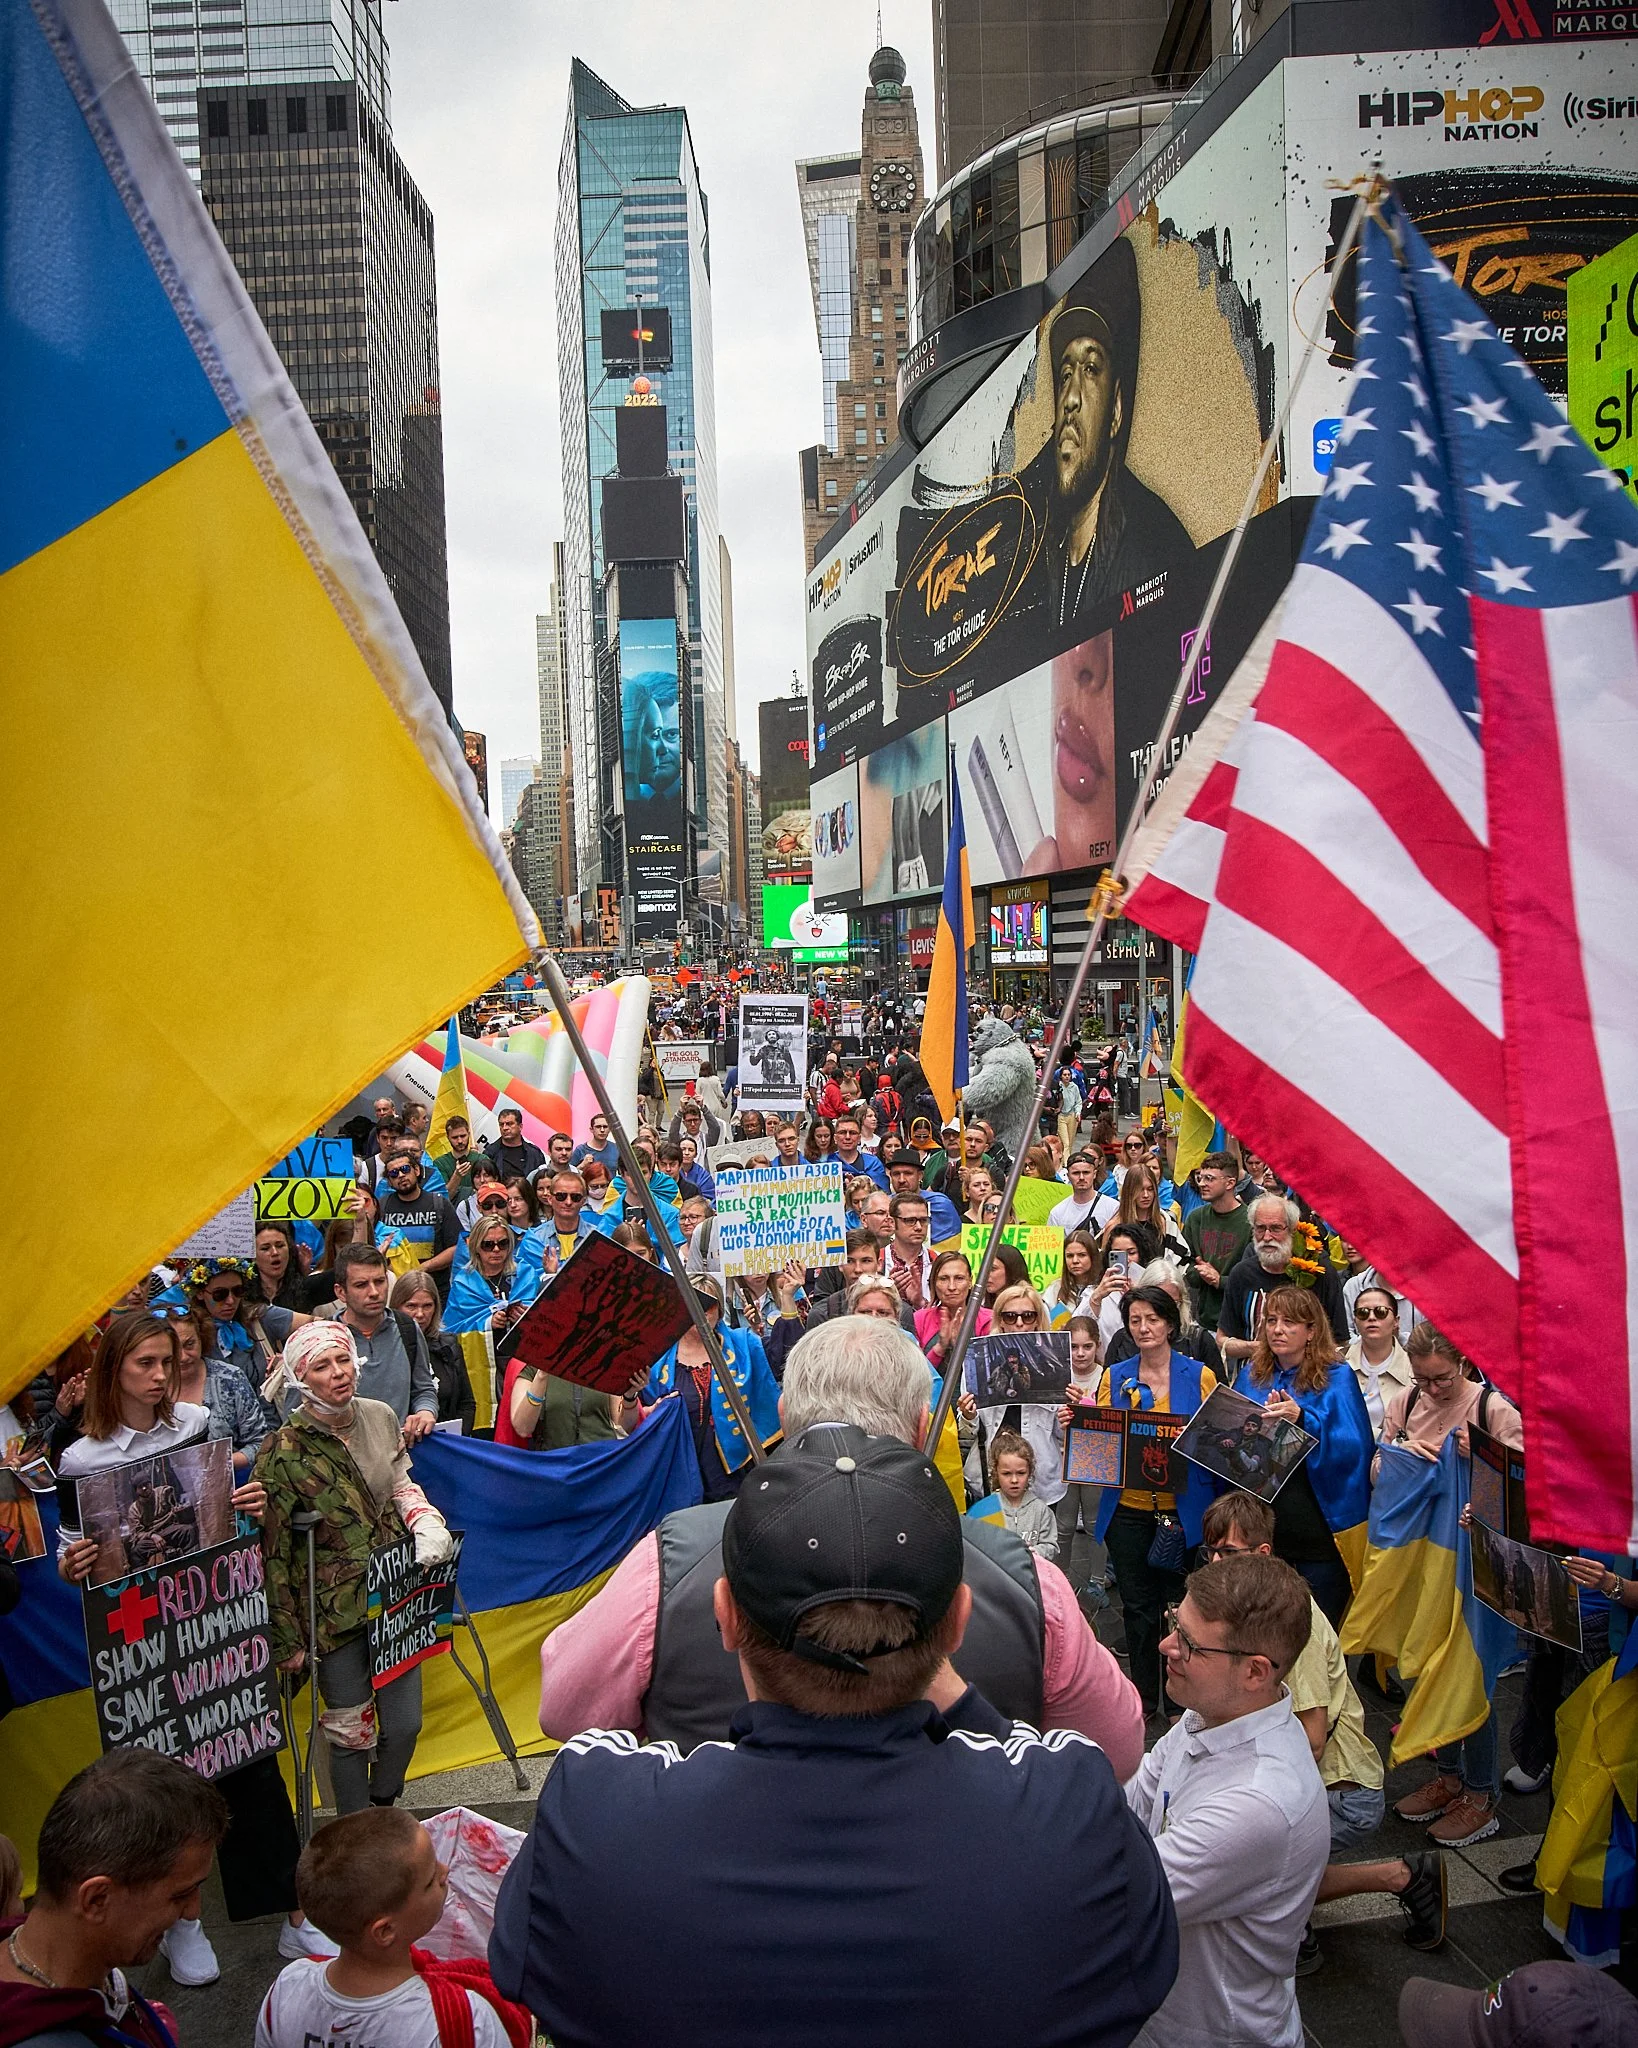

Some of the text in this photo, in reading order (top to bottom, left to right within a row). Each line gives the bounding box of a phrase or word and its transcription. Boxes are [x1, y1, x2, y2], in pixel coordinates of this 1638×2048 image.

[1586, 96, 1638, 120] Siri
[1444, 122, 1539, 142] NATION
[1138, 128, 1187, 193] MARRIOTT
[1138, 156, 1182, 212] MARQUIS
[1523, 325, 1565, 342] TOR
[901, 331, 941, 376] MARRIOTT
[903, 353, 935, 392] MARQUIS
[624, 394, 657, 407] 2022
[1136, 571, 1168, 597] MARRIOTT
[823, 586, 842, 613] NATION
[1136, 586, 1165, 608] MARQUIS
[933, 609, 986, 657] THE TOR GUIDE
[867, 699, 876, 714] APP
[998, 733, 1013, 772] REFY
[628, 844, 683, 854] STAIRCASE
[1089, 841, 1111, 859] REFY
[815, 950, 835, 959] NEW
[405, 1073, 436, 1101] Pneuhaus
[804, 1163, 840, 1177] АЗОВ
[717, 1188, 841, 1214] ВЕСЬ СВІТ МОЛИТЬСЯ
[745, 1209, 764, 1224] ЗА
[800, 1215, 833, 1230] БОГА
[722, 1225, 842, 1251] ЩОБ ДОПОМІГ ВАМ
[1029, 1234, 1057, 1243] DENYS
[1033, 1227, 1051, 1235] RIP
[1083, 1420, 1123, 1432] PETITION
[1101, 1410, 1123, 1421] SIGN
[158, 1565, 208, 1626] RED
[96, 1630, 166, 1692] SHOW
[103, 1634, 270, 1742] SAVE WOUNDED
[185, 1700, 229, 1743] WHO
[230, 1681, 269, 1727] ARE
